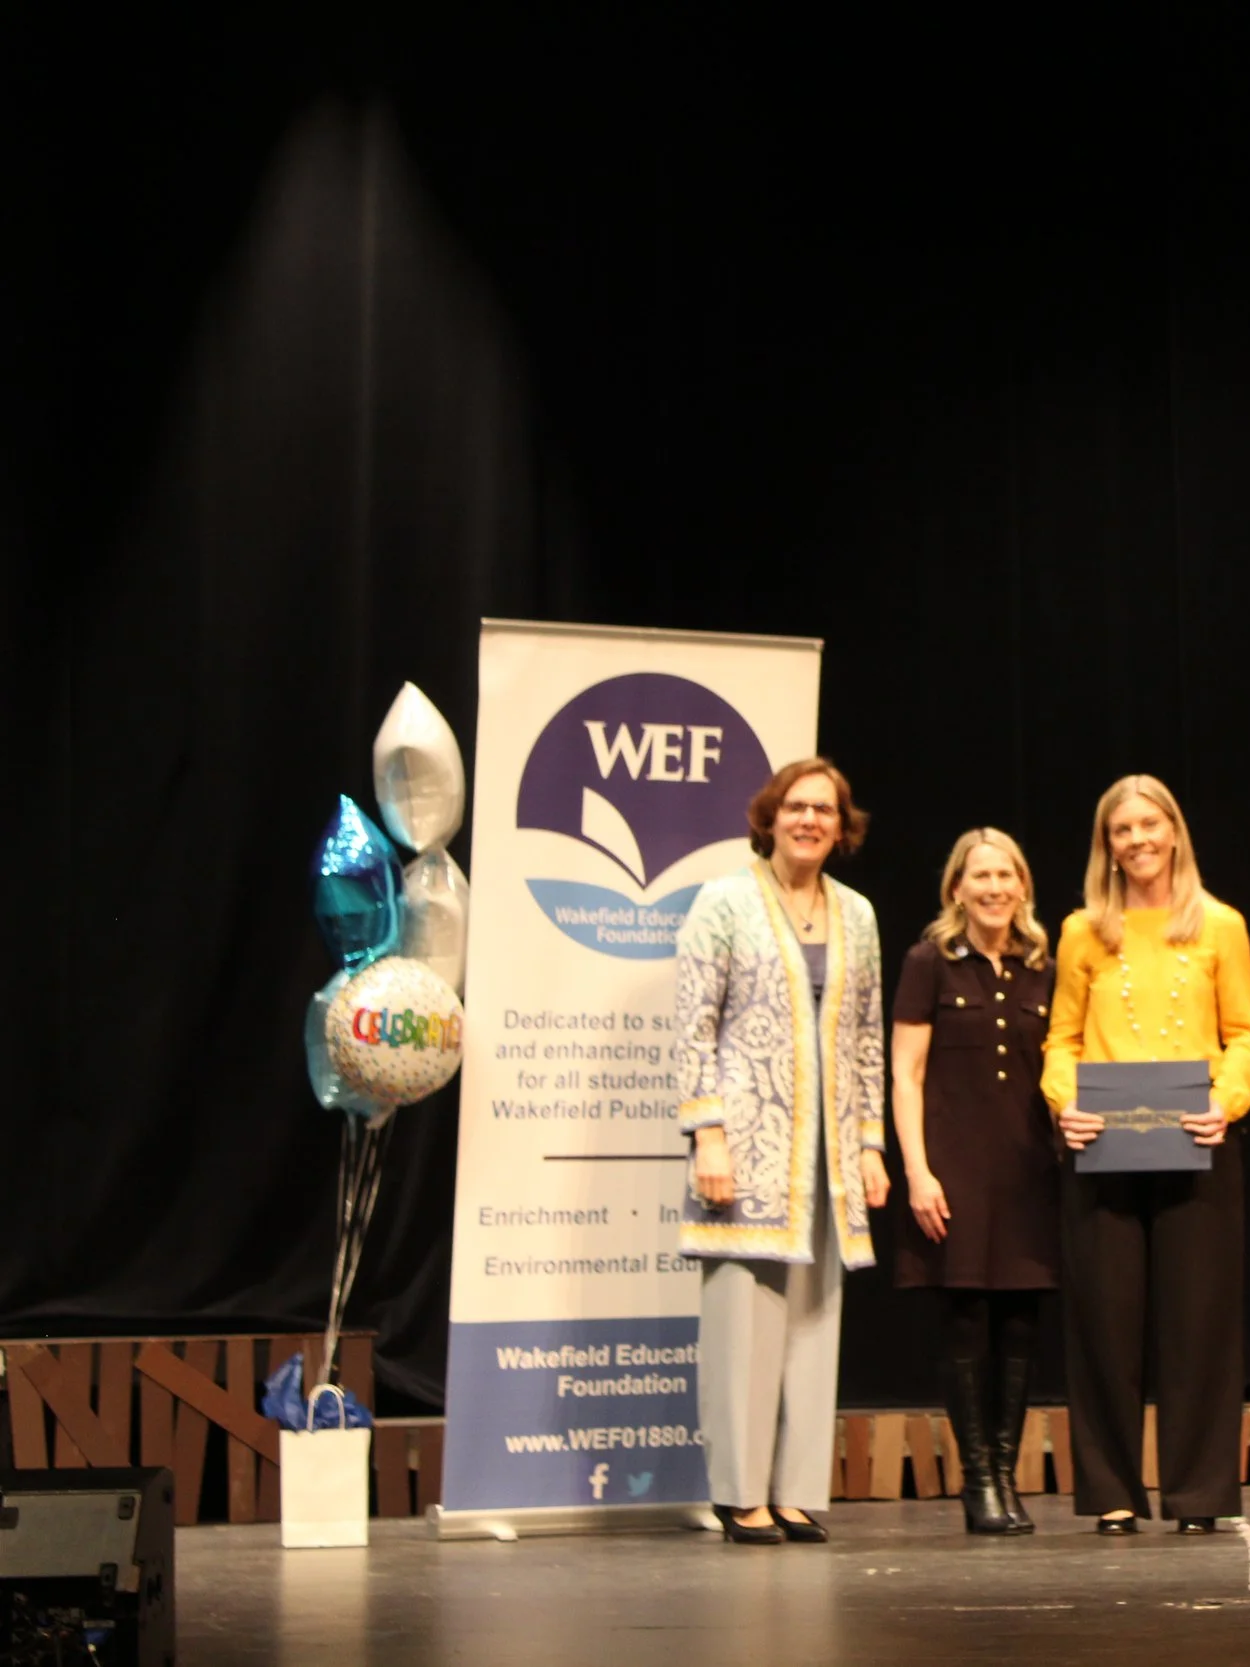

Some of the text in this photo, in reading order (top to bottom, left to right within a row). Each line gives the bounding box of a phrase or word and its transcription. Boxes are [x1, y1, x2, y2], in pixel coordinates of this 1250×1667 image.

[583, 720, 723, 783] WEF
[555, 906, 634, 926] Wakefield
[597, 925, 677, 945] Foundatio
[504, 1009, 616, 1031] Dedicated
[623, 1013, 644, 1031] to
[495, 1041, 537, 1060] and
[543, 1040, 660, 1066] enhancing
[517, 1070, 546, 1090] for
[554, 1070, 580, 1090] all
[492, 1099, 678, 1120] Wakefield Public
[479, 1204, 609, 1227] Enrichment
[484, 1253, 648, 1276] Environmental
[496, 1344, 609, 1370] Wakefield
[557, 1372, 687, 1397] Foundation
[505, 1424, 704, 1453] www.WEF01880.o
[588, 1462, 609, 1499] f
